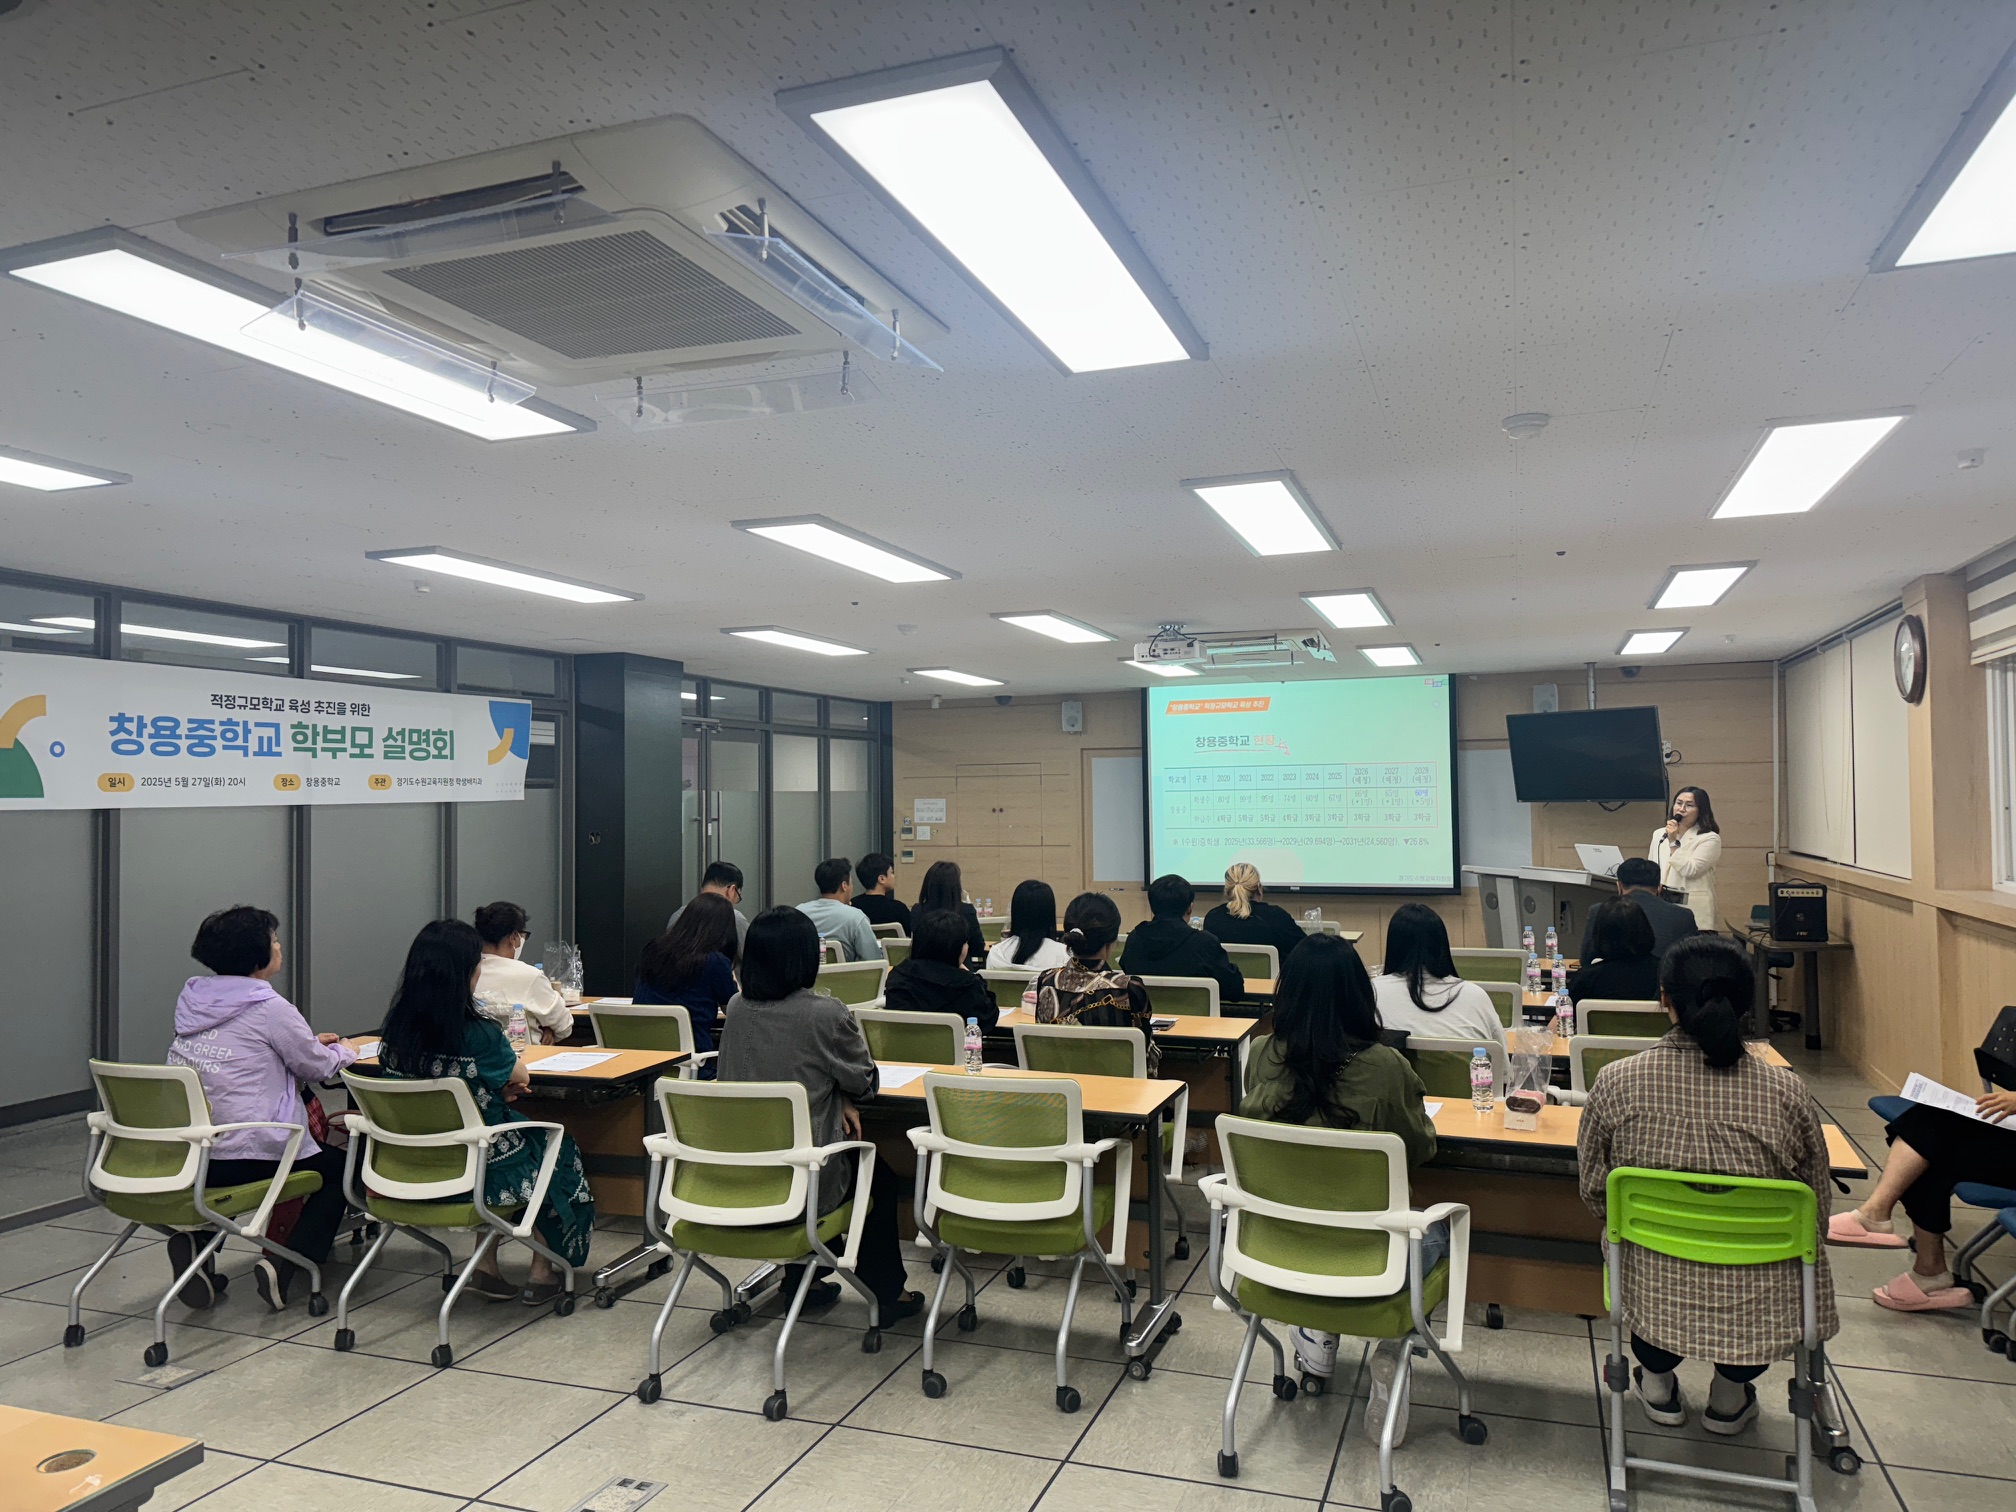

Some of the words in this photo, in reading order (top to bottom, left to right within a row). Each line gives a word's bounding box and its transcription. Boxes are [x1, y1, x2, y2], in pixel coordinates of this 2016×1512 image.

[210, 694, 285, 712] 적정규모학교
[288, 699, 311, 714] 육성
[314, 700, 347, 716] 추진을
[349, 702, 371, 717] 위한
[108, 712, 283, 758] 창용중학교
[290, 721, 375, 760] 학부모
[381, 726, 455, 762] 설명회
[1195, 735, 1250, 748] 창용중학교
[1254, 734, 1276, 746] 현황
[1354, 767, 1369, 776] 2026
[1384, 767, 1399, 775] 2027
[107, 776, 126, 788] 일시
[140, 776, 172, 788] 2025년
[174, 776, 189, 788] 5월
[191, 776, 226, 788] 27일(화)
[228, 776, 246, 787] 20시
[280, 777, 295, 787] 장소
[305, 777, 341, 788] 창용중학교
[373, 777, 386, 787] 주관
[396, 777, 454, 787] 경기도수원교육지원청
[455, 777, 483, 787] 학생배치과
[1195, 775, 1208, 784] 구분
[1217, 774, 1231, 783] 2020
[1239, 774, 1252, 782] 2021
[1260, 773, 1275, 781] 2022
[1282, 773, 1297, 781] 2023
[1305, 772, 1319, 780] 2024
[1328, 772, 1342, 780] 2025
[1414, 788, 1429, 797] 60명
